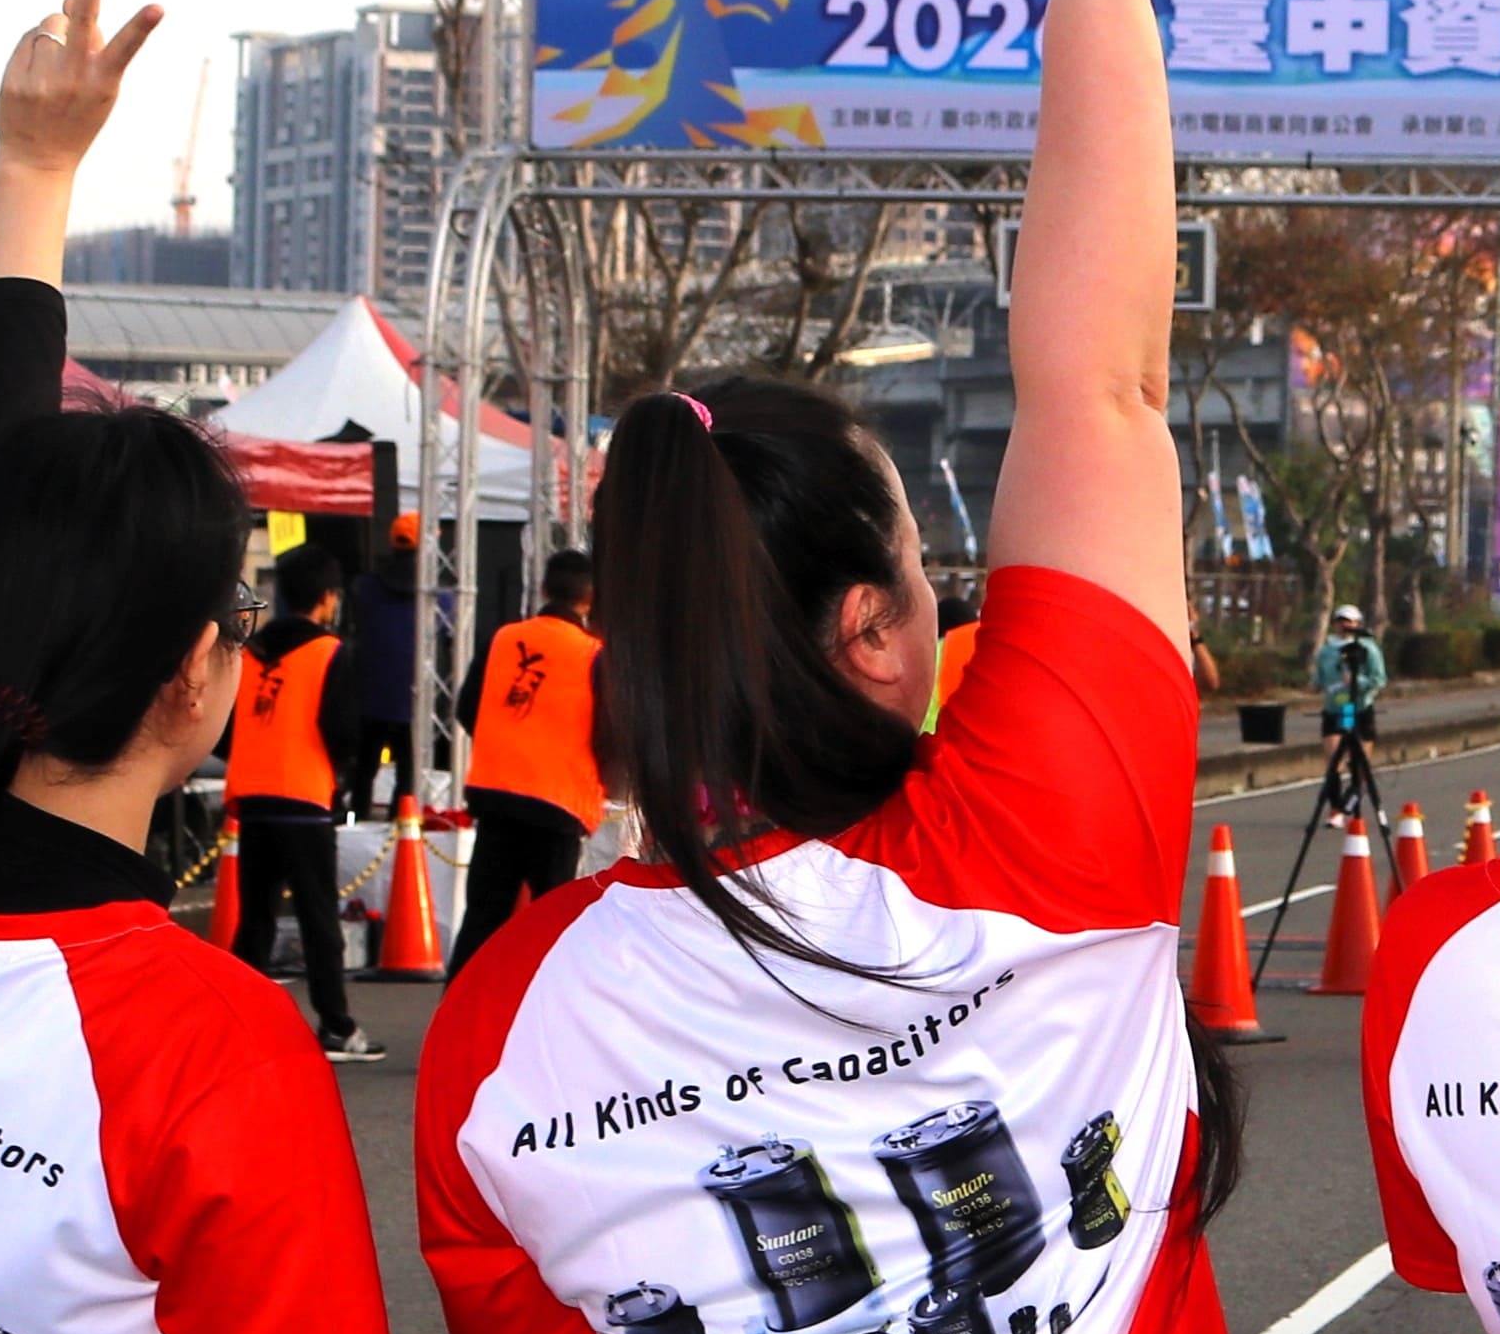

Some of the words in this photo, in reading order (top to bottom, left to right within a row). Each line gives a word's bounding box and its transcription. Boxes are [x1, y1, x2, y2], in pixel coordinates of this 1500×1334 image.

[1171, 112, 1373, 135] 市電腦商業同業公會
[511, 1111, 576, 1158] All
[595, 1079, 702, 1140] Kinds
[725, 1066, 766, 1102] of
[781, 968, 1016, 1085] Capacitors
[1424, 1081, 1465, 1118] All
[932, 1173, 994, 1210] Suntan
[756, 1223, 824, 1252] Suntan
